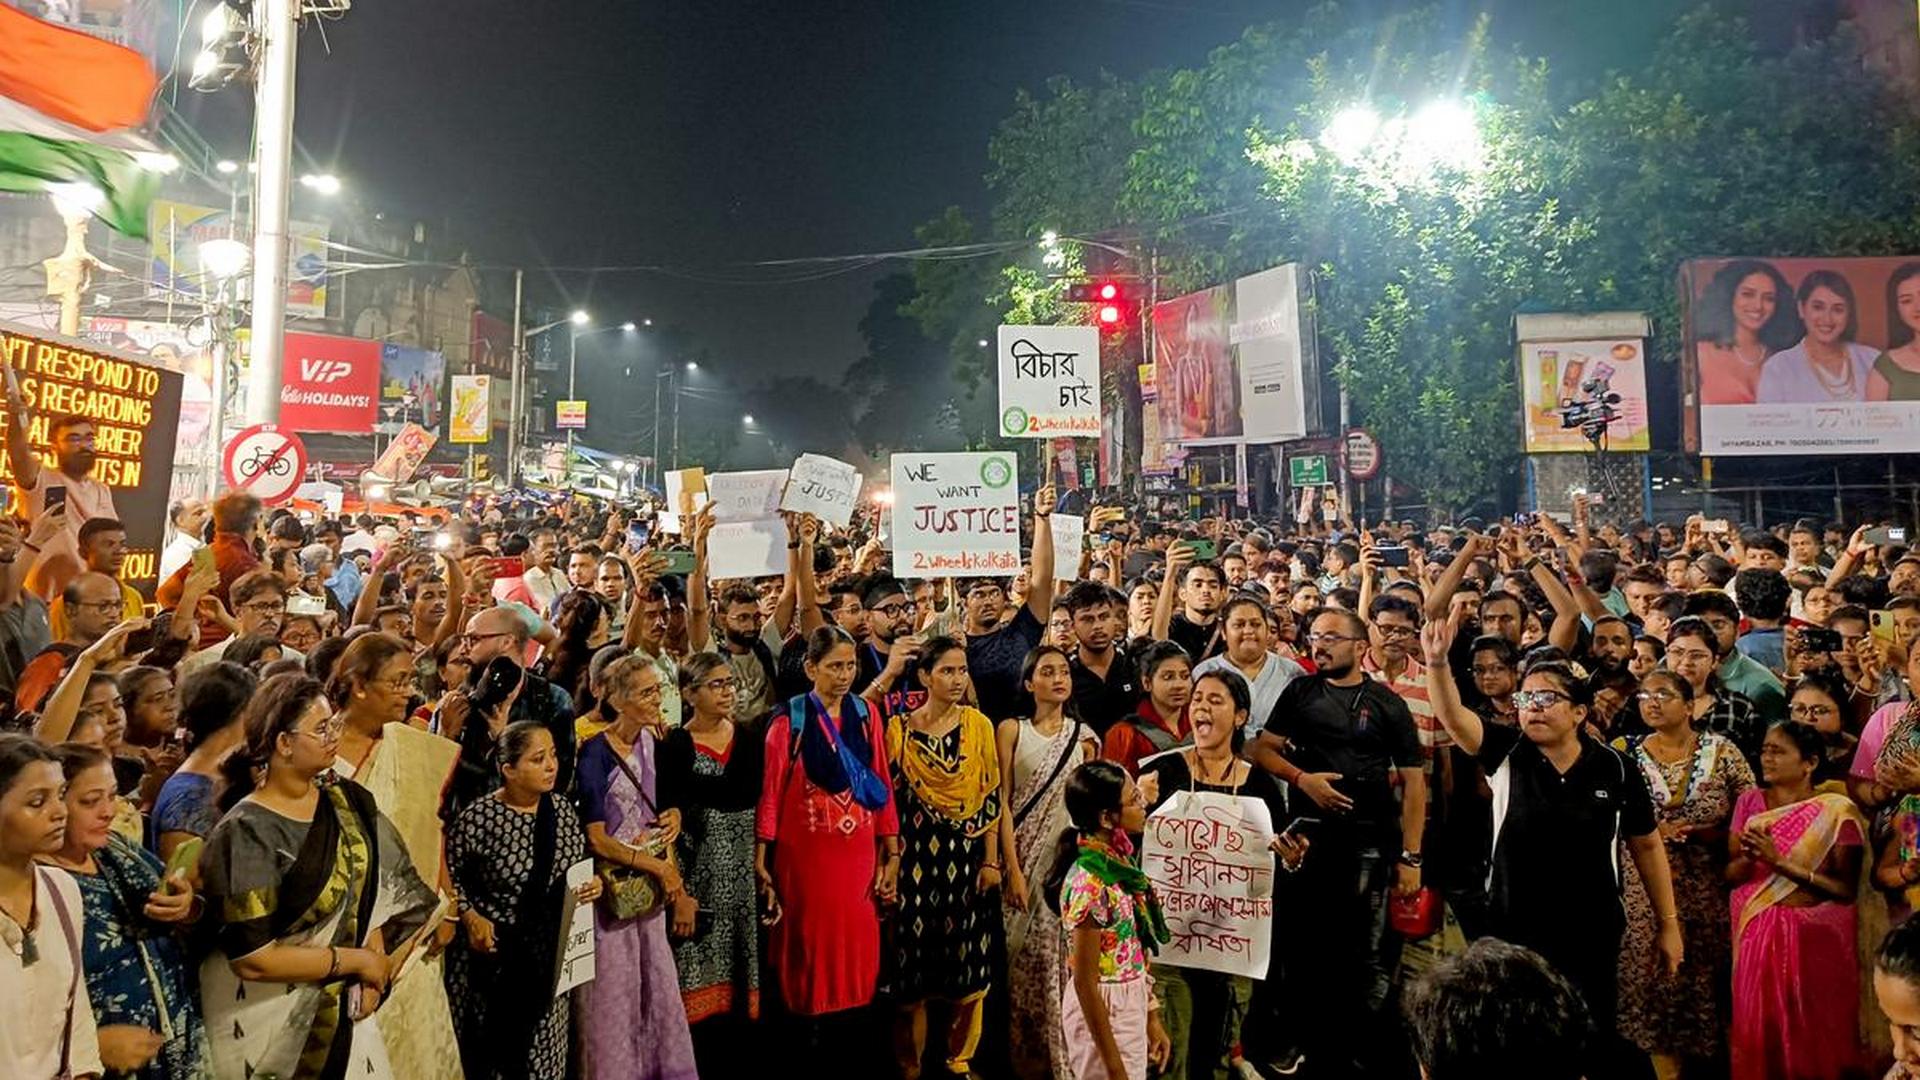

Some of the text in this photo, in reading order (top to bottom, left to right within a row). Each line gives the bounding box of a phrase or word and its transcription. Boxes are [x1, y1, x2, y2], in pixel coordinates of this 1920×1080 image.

[36, 345, 133, 390] RESPOND
[137, 367, 160, 396] TO
[301, 358, 352, 383] VIP
[1011, 339, 1079, 378] বিচার
[41, 382, 152, 425] REGARDING
[302, 391, 370, 407] HOLIDAYS!
[1060, 376, 1093, 407] চাই
[122, 460, 141, 487] IN
[904, 463, 938, 482] WE
[936, 486, 982, 498] WANT
[914, 506, 1017, 533] JUSTICE
